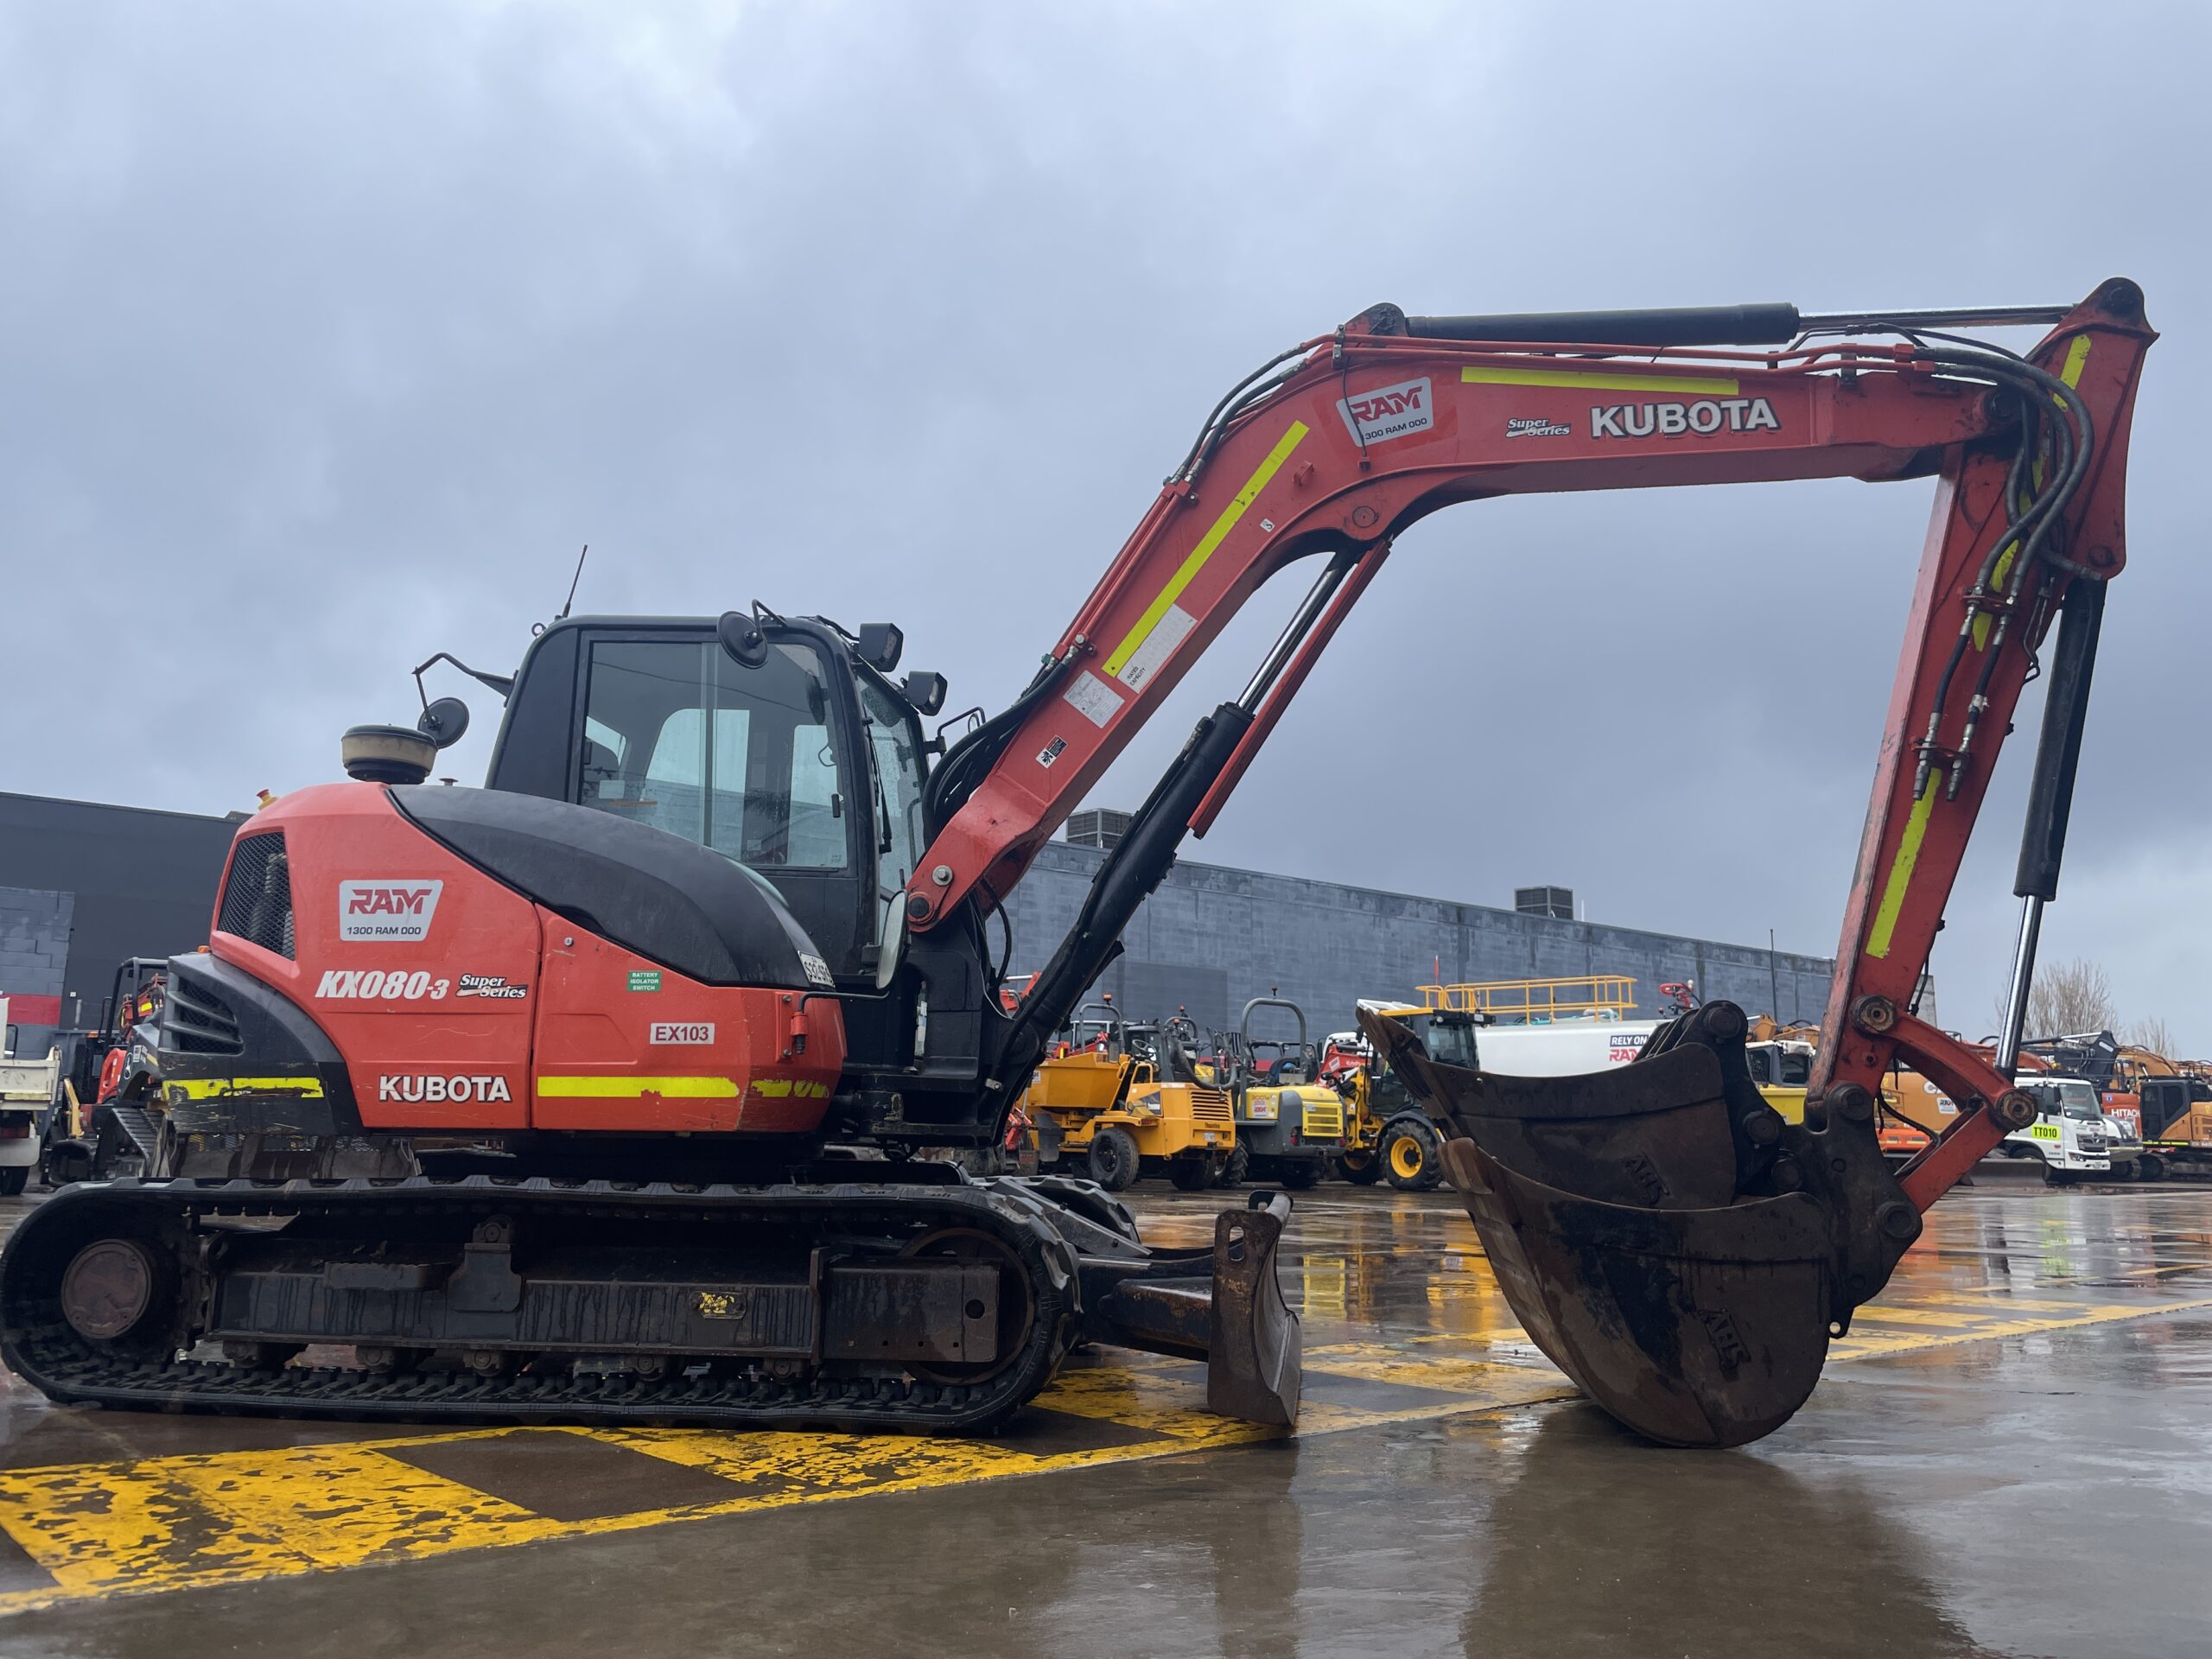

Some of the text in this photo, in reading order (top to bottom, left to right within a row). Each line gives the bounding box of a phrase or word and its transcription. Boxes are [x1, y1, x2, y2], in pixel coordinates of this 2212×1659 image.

[1350, 385, 1423, 424] RAM
[1507, 418, 1549, 430] Super
[1590, 397, 1779, 438] KUBOTA
[1362, 417, 1427, 441] 300 RAM 000
[1527, 426, 1570, 436] Series
[1129, 667, 1147, 686] CAPACITY
[348, 889, 433, 914] RAM
[346, 926, 422, 935] 1300 RAM 000
[315, 970, 450, 1000] KX080-3
[459, 974, 506, 989] Super
[480, 986, 527, 999] Series
[655, 1026, 709, 1041] EX103
[1611, 1036, 1648, 1046] RELY ON
[378, 1075, 512, 1103] KUBOTA
[2033, 1126, 2057, 1138] TT010
